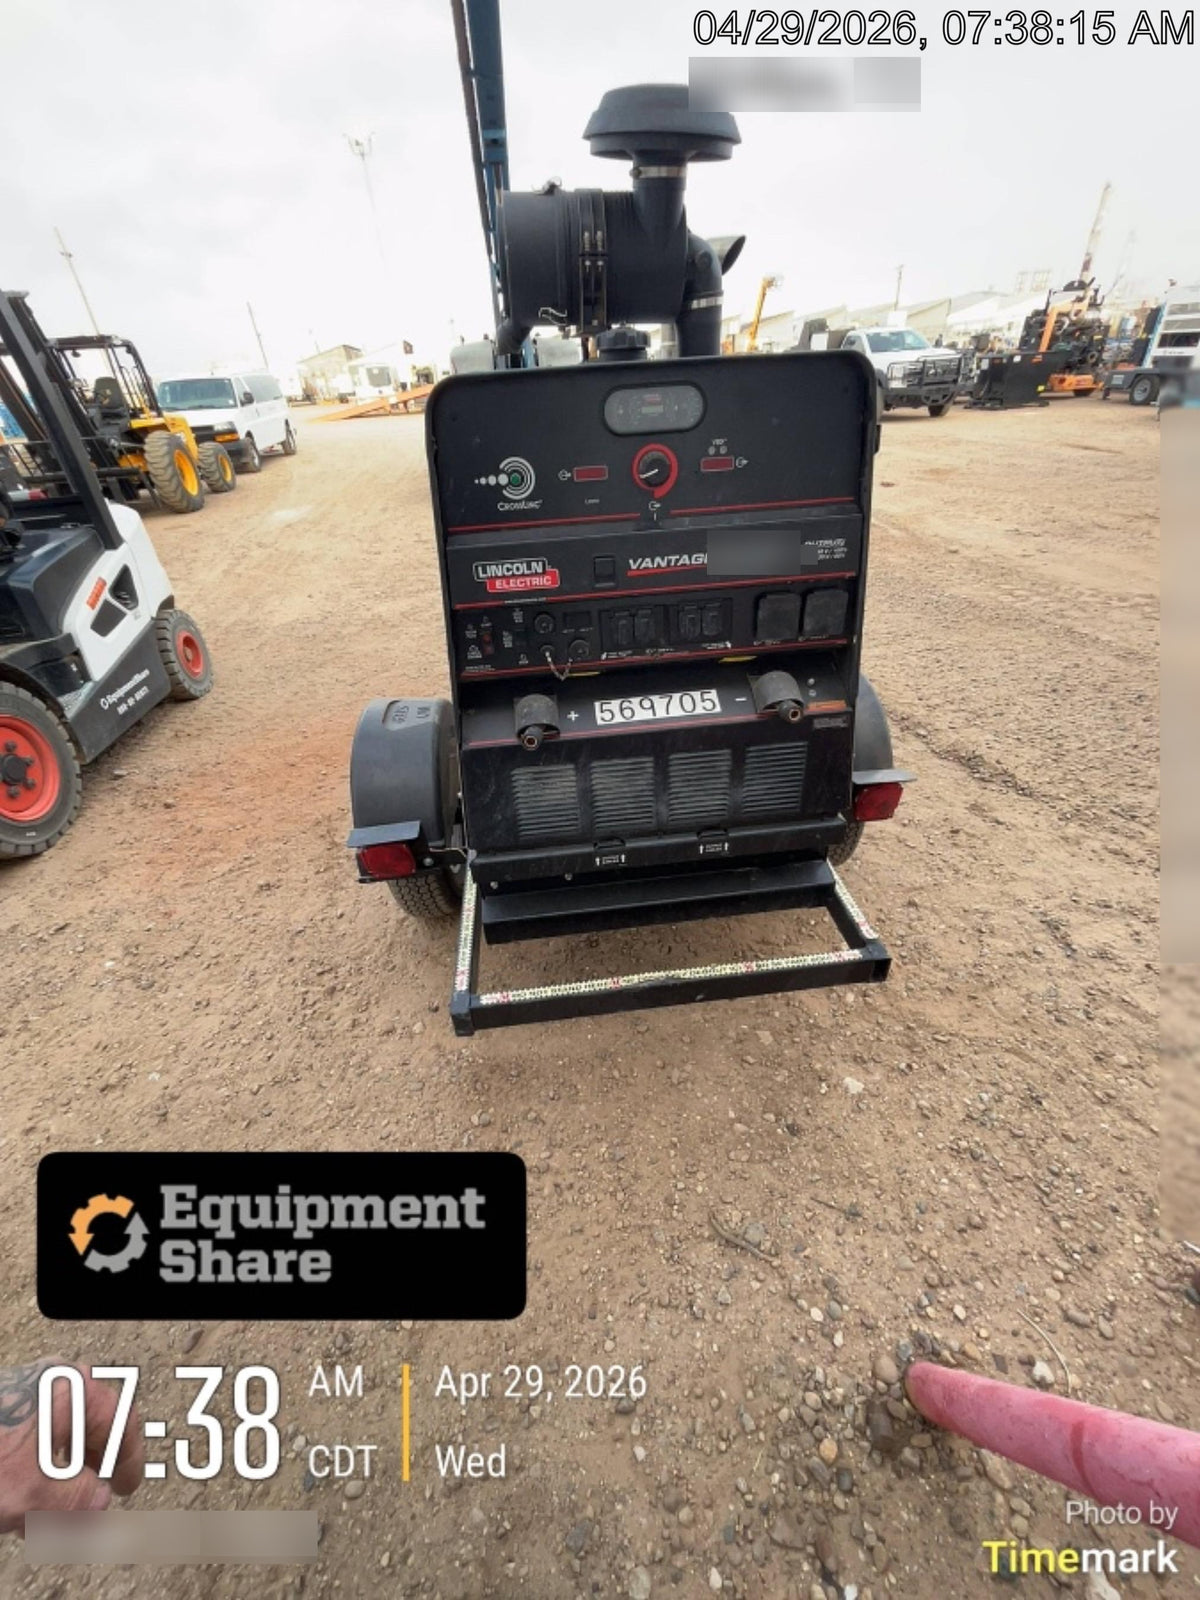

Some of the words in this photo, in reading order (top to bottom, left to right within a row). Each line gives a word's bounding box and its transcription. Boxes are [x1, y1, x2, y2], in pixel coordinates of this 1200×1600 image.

[478, 561, 543, 578] LINCOLN
[495, 575, 552, 589] ELECTRIC
[600, 690, 717, 723] 569705
